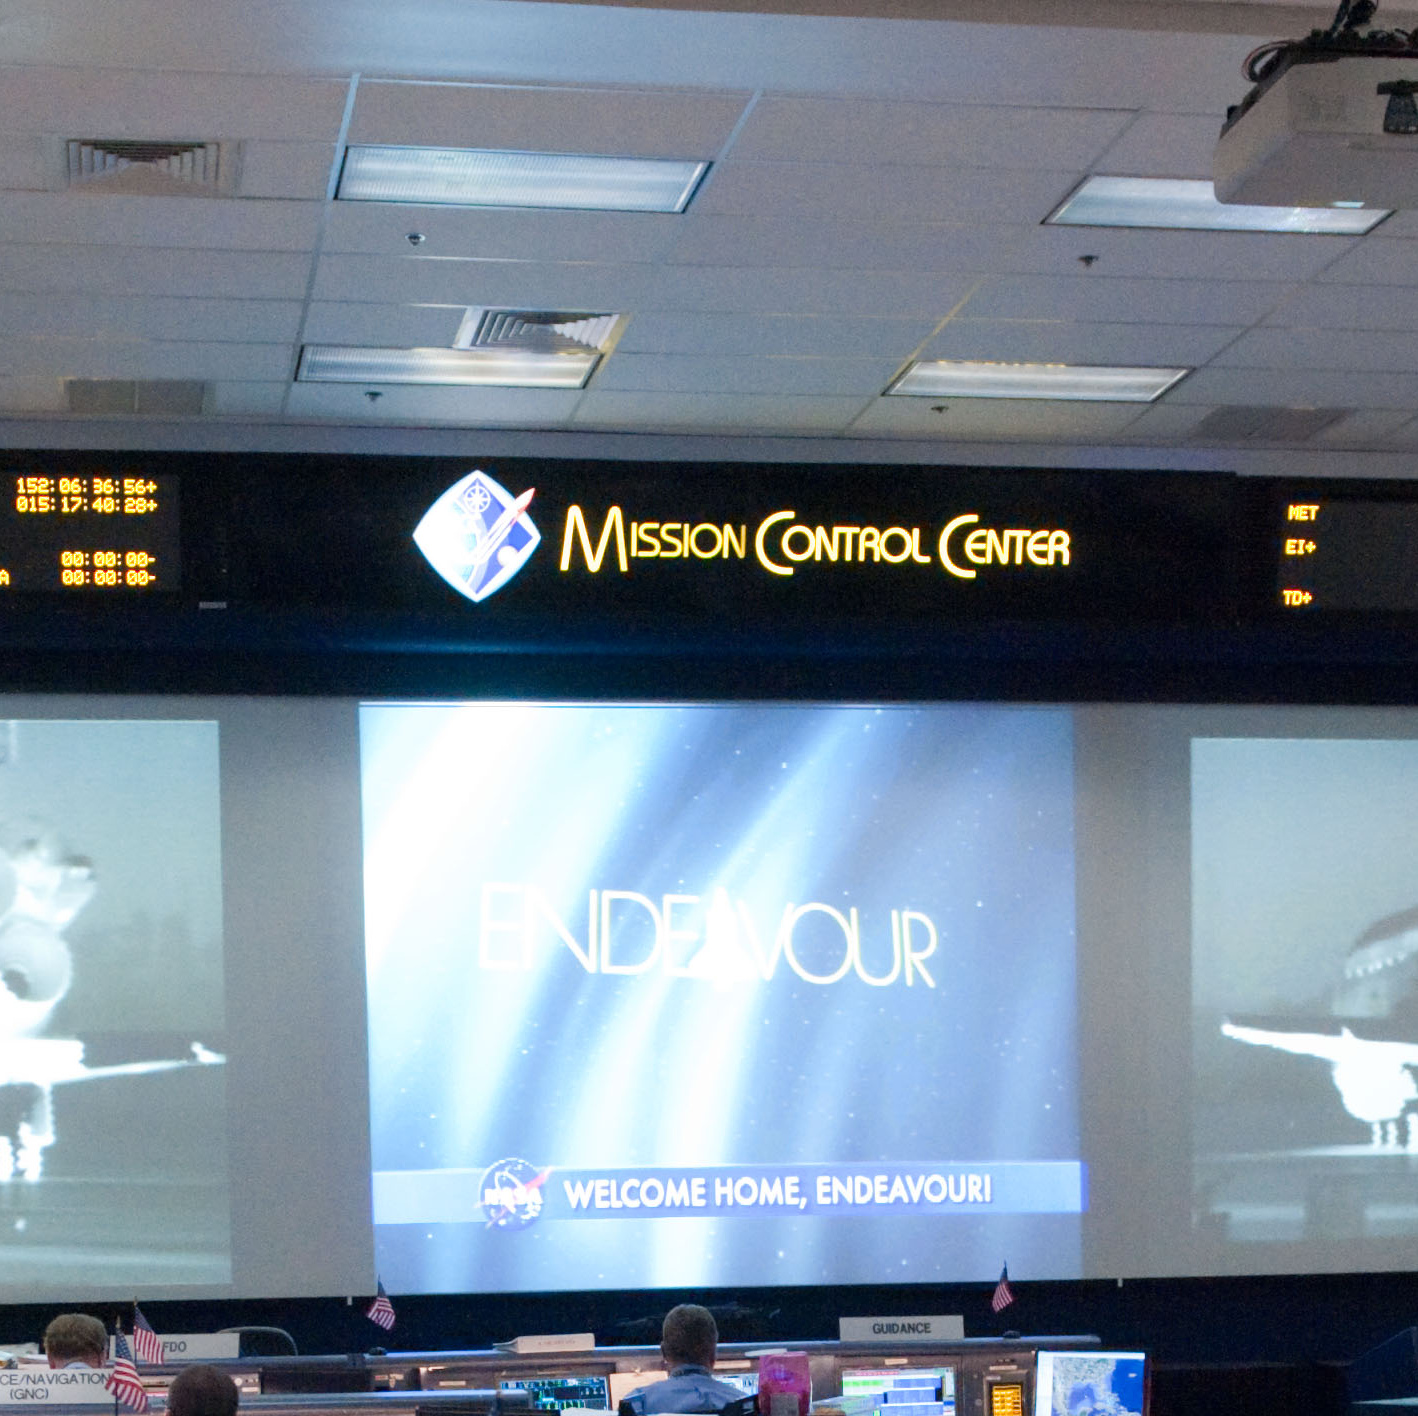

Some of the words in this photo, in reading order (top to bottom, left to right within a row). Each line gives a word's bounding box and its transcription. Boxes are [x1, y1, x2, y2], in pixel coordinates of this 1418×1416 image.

[16, 477, 158, 495] 152:06:36:56+
[15, 496, 158, 513] 015:17:40:28+
[1287, 504, 1320, 521] MET
[563, 1178, 707, 1210] WELCOME
[714, 1175, 808, 1209] HOME,
[872, 1322, 932, 1334] GUIDANCE
[9, 1387, 49, 1400] (GNC)
